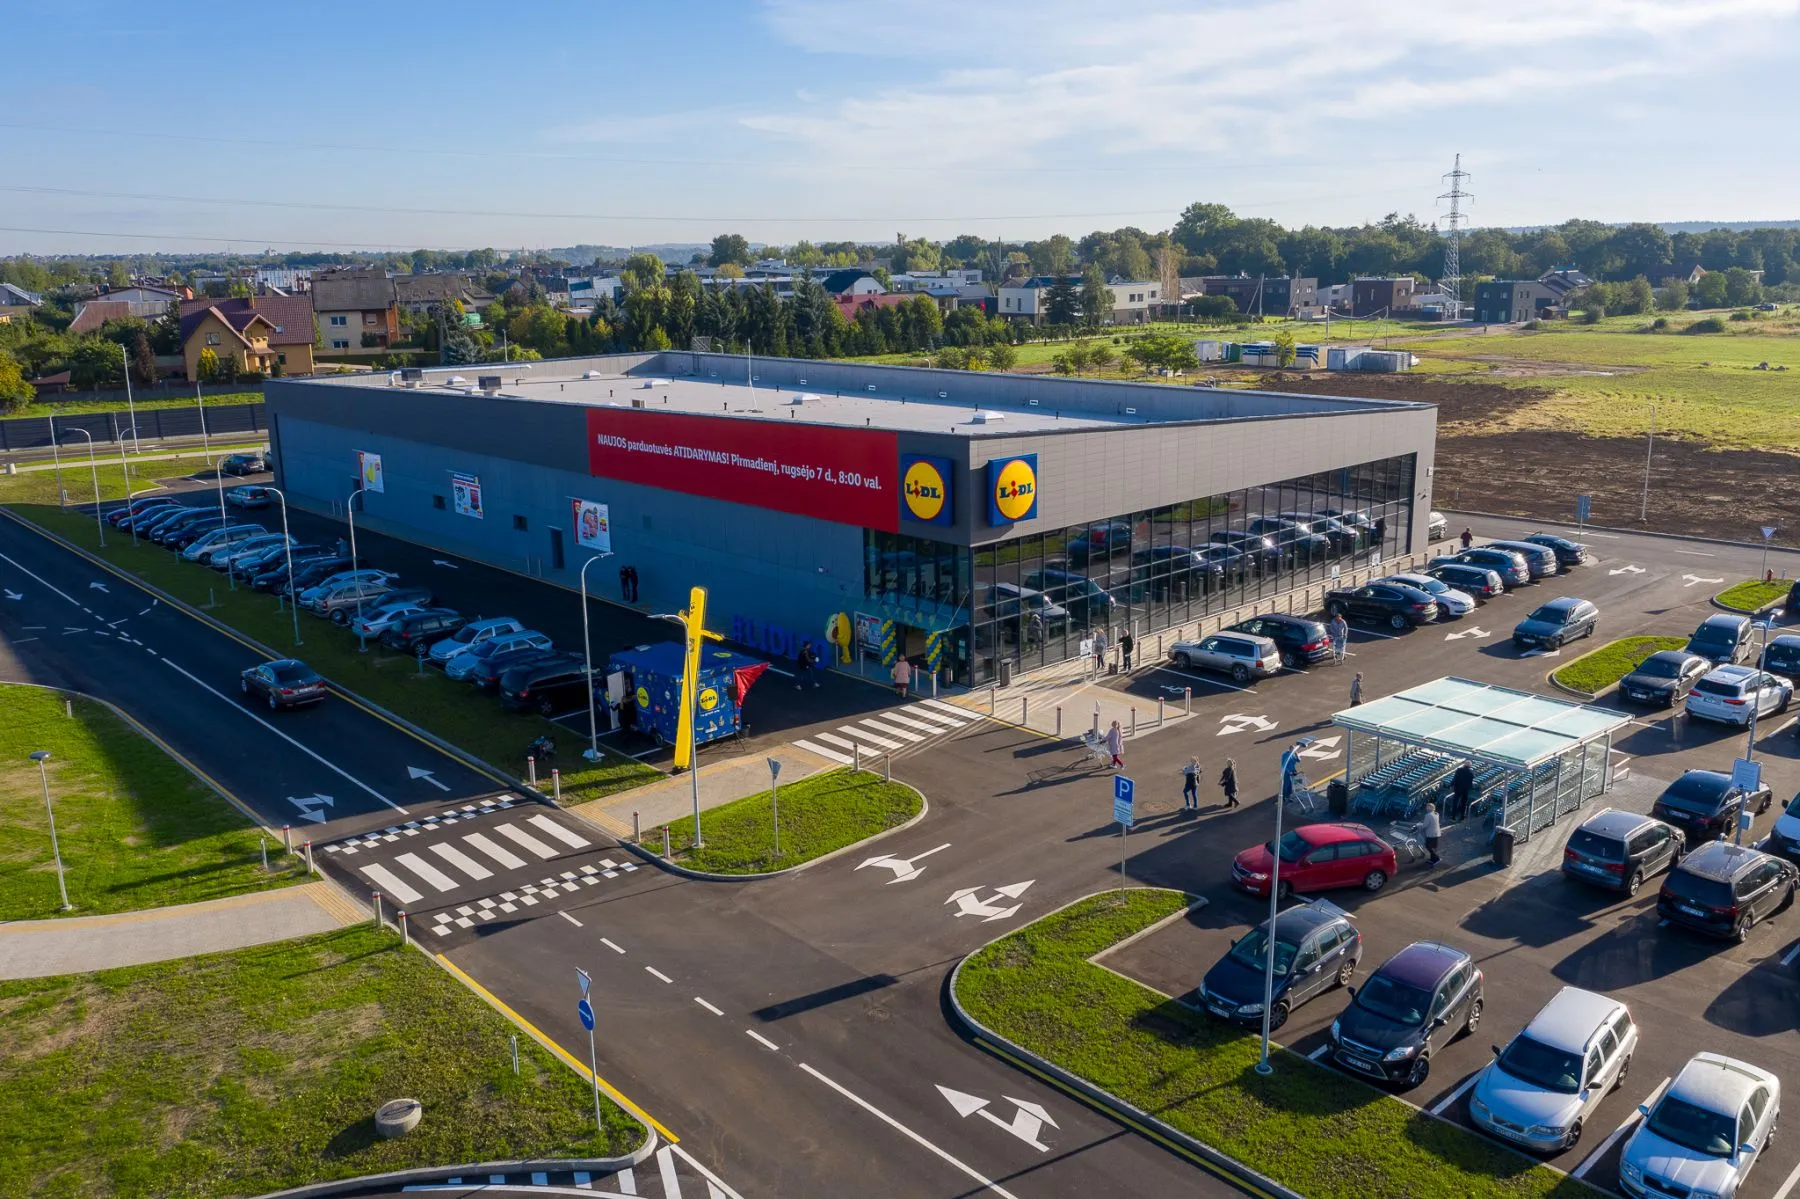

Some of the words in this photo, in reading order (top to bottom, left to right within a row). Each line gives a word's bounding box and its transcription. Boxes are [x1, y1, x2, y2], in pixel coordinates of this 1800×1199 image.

[597, 433, 627, 449] NAUJOS
[627, 440, 673, 456] parduotuvės
[673, 445, 730, 465] ATIDARYMAS!
[731, 453, 780, 475] Pirmadienį,
[781, 464, 815, 480] rugsėjo
[816, 467, 823, 480] 7
[825, 468, 837, 484] d.,
[838, 471, 861, 486] 8:00
[864, 476, 882, 490] val.
[1119, 779, 1130, 797] P
